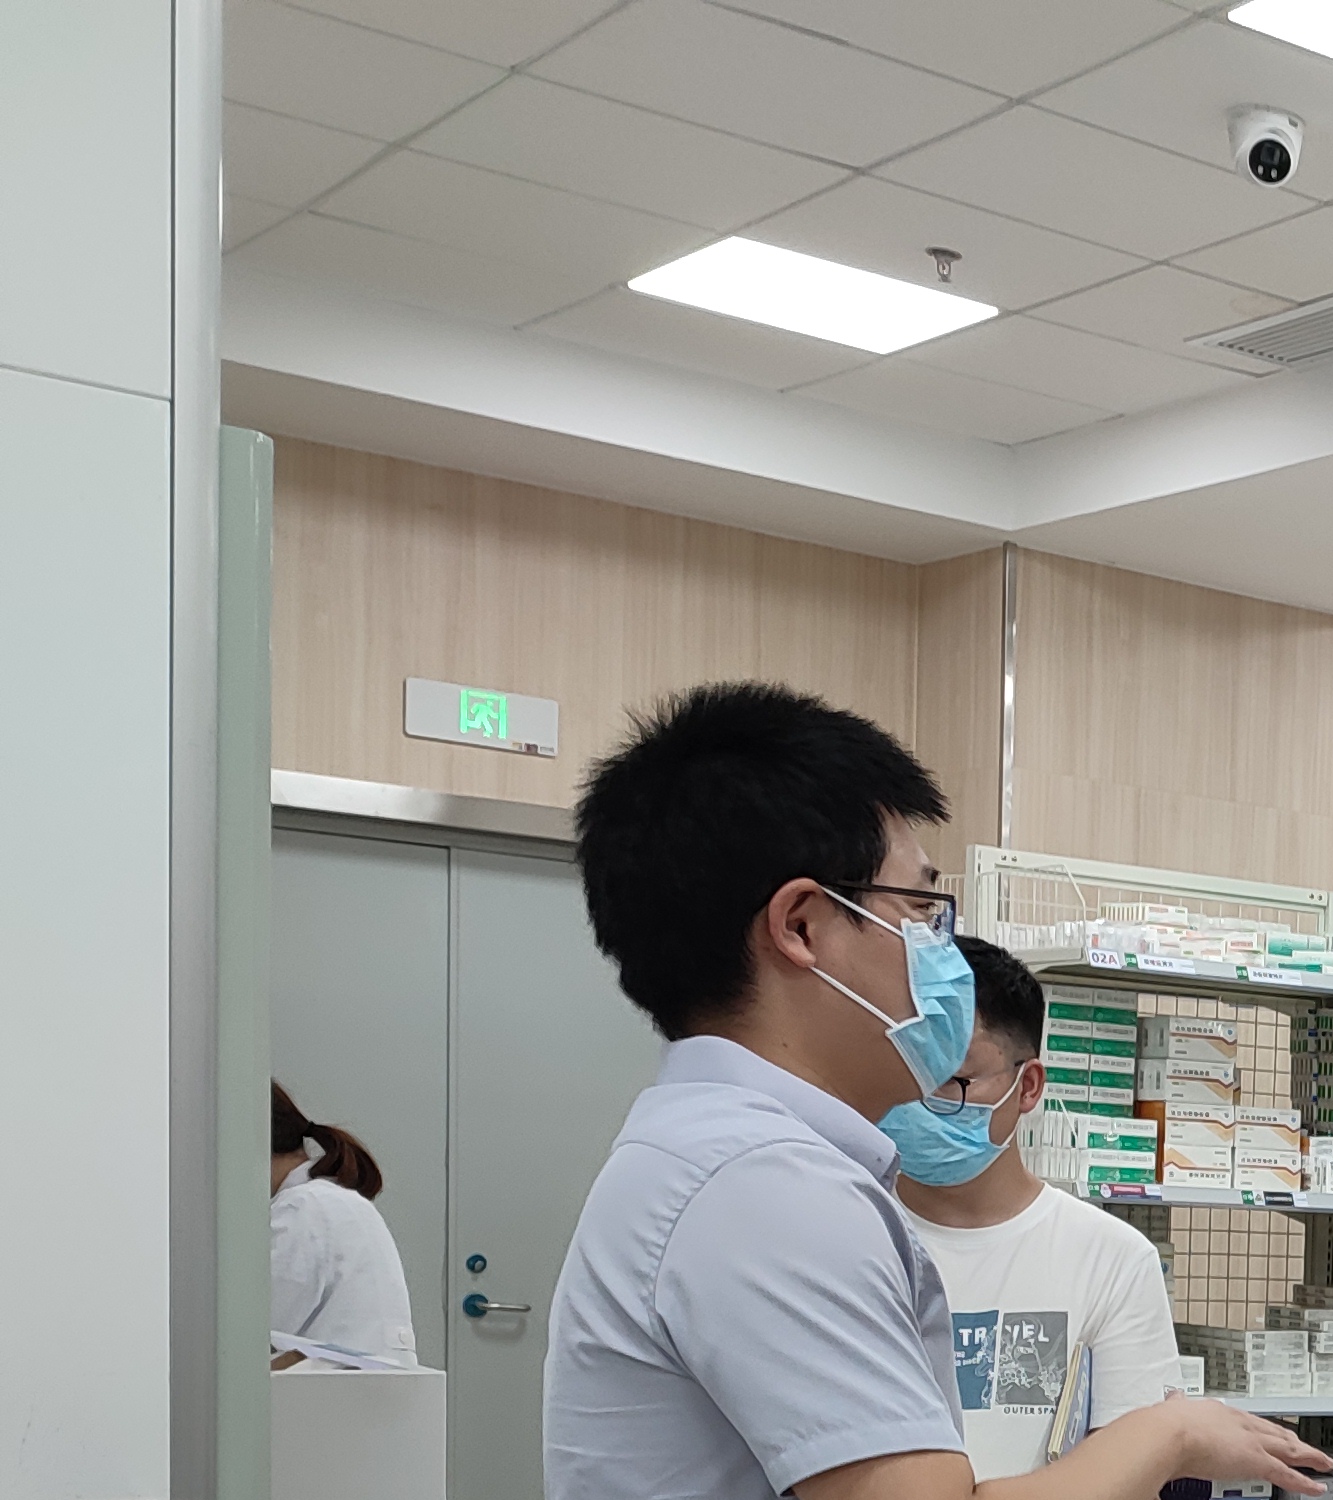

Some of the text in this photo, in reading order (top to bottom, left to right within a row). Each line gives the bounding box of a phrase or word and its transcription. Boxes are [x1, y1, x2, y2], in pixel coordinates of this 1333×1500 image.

[1091, 951, 1118, 965] 02A
[958, 1320, 1050, 1347] TRVEL
[1003, 1406, 1056, 1415] OUTER SPA
